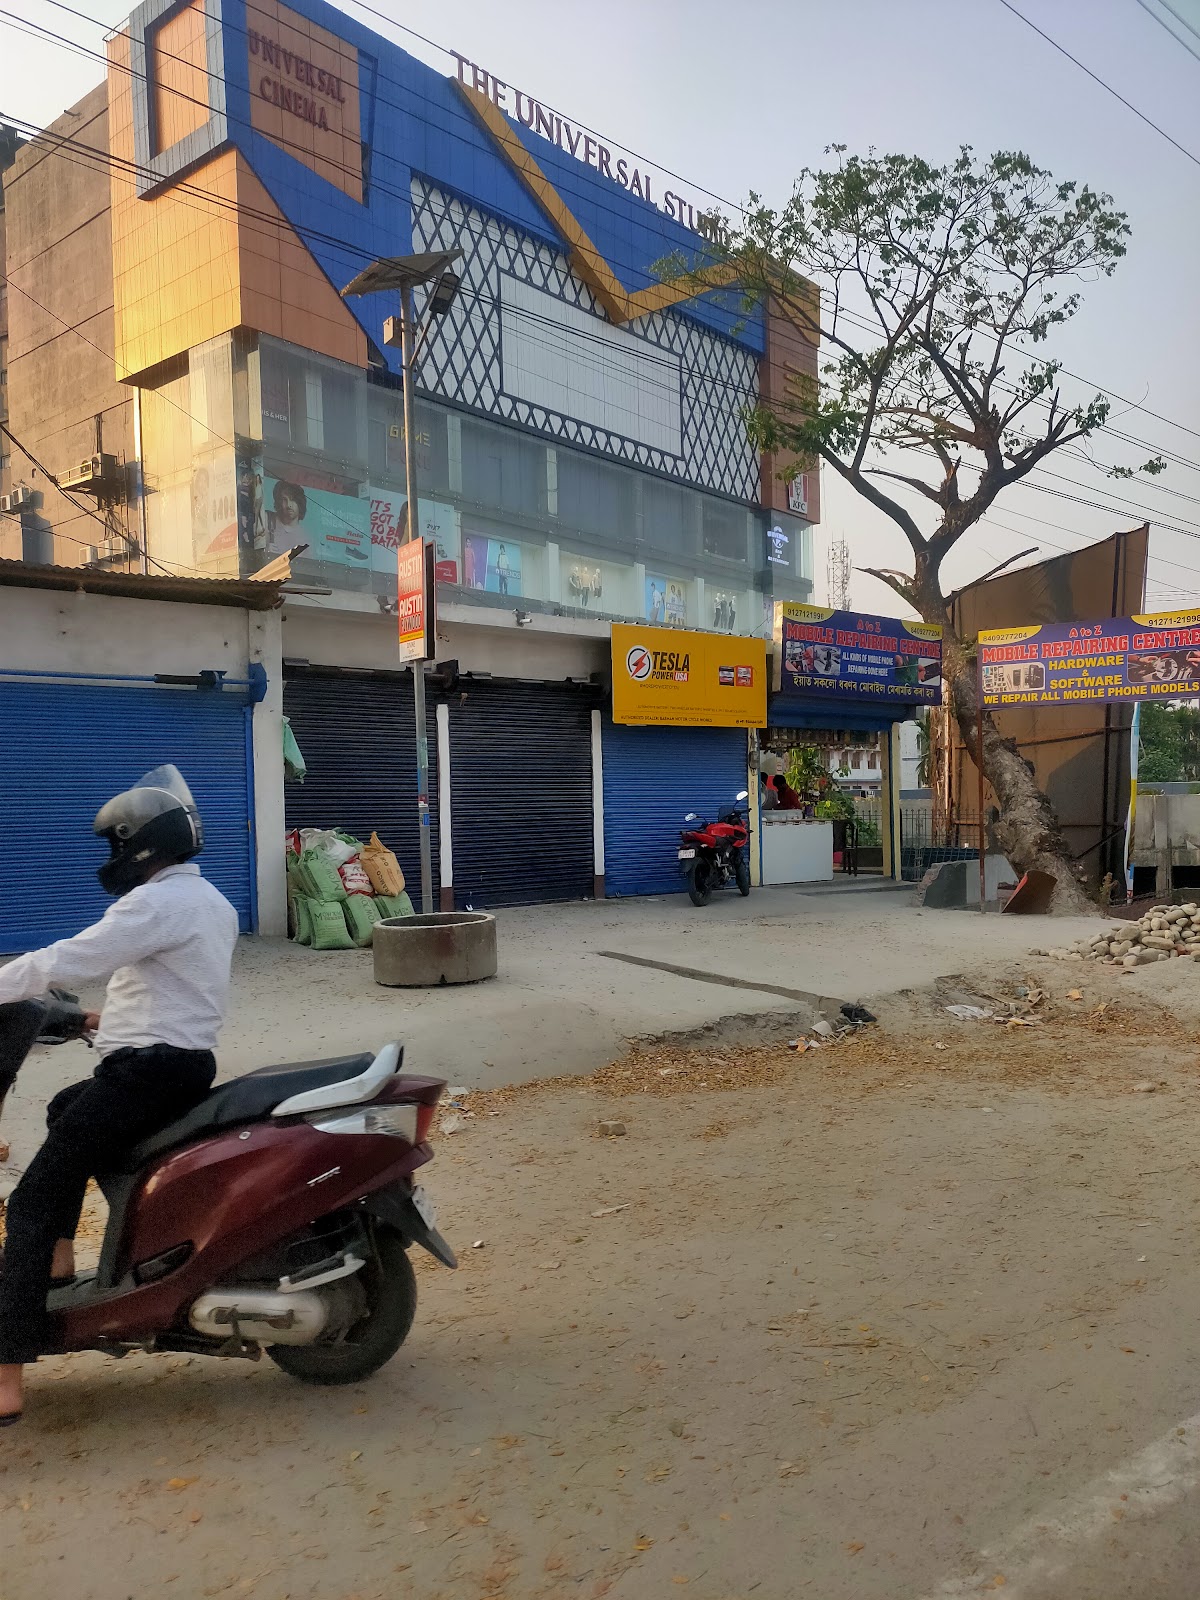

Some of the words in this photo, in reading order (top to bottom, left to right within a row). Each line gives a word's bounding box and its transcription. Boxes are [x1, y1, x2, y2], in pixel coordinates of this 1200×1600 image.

[248, 27, 345, 104] UNIVERSAL
[260, 76, 329, 132] CINEMA
[450, 49, 508, 116] THE
[514, 90, 657, 208] UNIVERSAL
[370, 500, 392, 513] IT'S
[792, 500, 806, 512] KFC
[370, 512, 395, 525] GOT
[371, 522, 385, 535] TO
[371, 533, 400, 548] BATA
[399, 554, 422, 580] AUSTIN
[500, 568, 521, 579] TRENDS
[399, 594, 423, 619] AUSTIN
[857, 619, 864, 631] A
[865, 622, 874, 632] to
[875, 621, 882, 633] Z
[1069, 627, 1078, 638] A
[1080, 627, 1092, 637] to
[1094, 624, 1103, 636] Z
[786, 622, 834, 645] MOBILE
[836, 629, 898, 653] REPAIRING
[900, 638, 941, 659] CENTRE
[982, 632, 1028, 642] 8409277204
[982, 644, 1039, 663] MOBILE
[1041, 635, 1129, 659] REPAIRING
[1133, 628, 1200, 651] CENTRE
[652, 651, 690, 672] TESLA
[1048, 655, 1124, 671] HARDWARE
[651, 671, 674, 681] POWER
[676, 673, 688, 682] USA
[1082, 669, 1089, 677] &
[1050, 675, 1123, 690] SOFTWARE
[984, 695, 999, 705] WE
[1001, 691, 1038, 704] REPAIR
[1041, 690, 1060, 702] ALL
[1063, 687, 1105, 700] MOBILE
[1108, 685, 1148, 698] PHONE
[1151, 681, 1200, 695] MODELS
